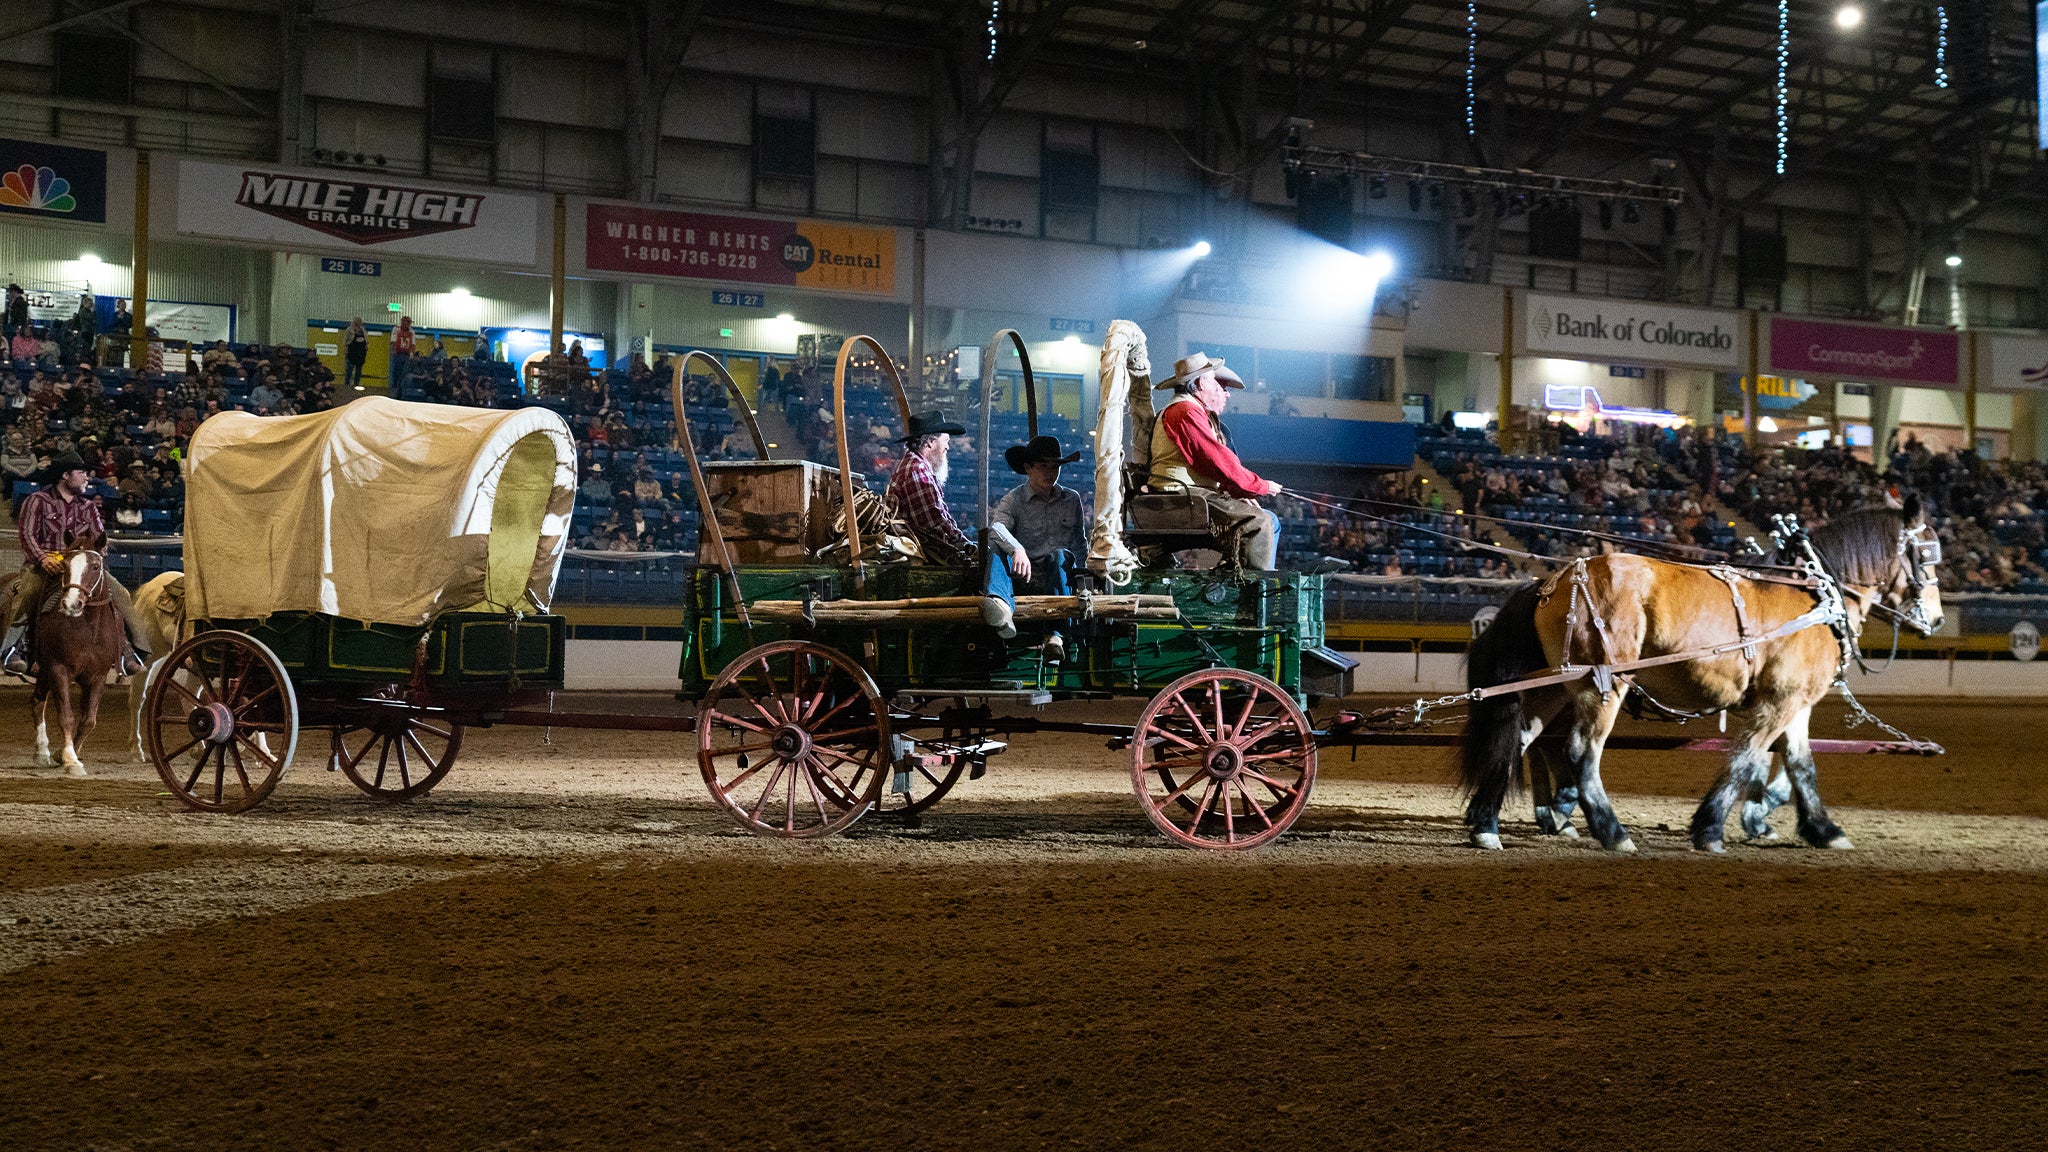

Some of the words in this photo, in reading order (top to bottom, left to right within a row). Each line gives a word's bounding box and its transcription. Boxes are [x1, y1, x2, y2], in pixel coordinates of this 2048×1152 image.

[242, 174, 354, 212] MILE
[362, 187, 480, 225] HIGH
[307, 211, 409, 230] GRAPHICS
[606, 221, 696, 246] WAGNER
[709, 231, 770, 251] RENTS
[622, 243, 757, 269] 1-800-736-8228
[783, 243, 810, 262] CAT
[818, 248, 881, 270] Rental
[328, 260, 345, 272] 25
[358, 263, 375, 275] 26
[718, 292, 733, 304] 26
[744, 294, 758, 306] 27
[1556, 312, 1609, 340] Bank
[1613, 317, 1635, 342] of
[1639, 320, 1732, 350] Colorado
